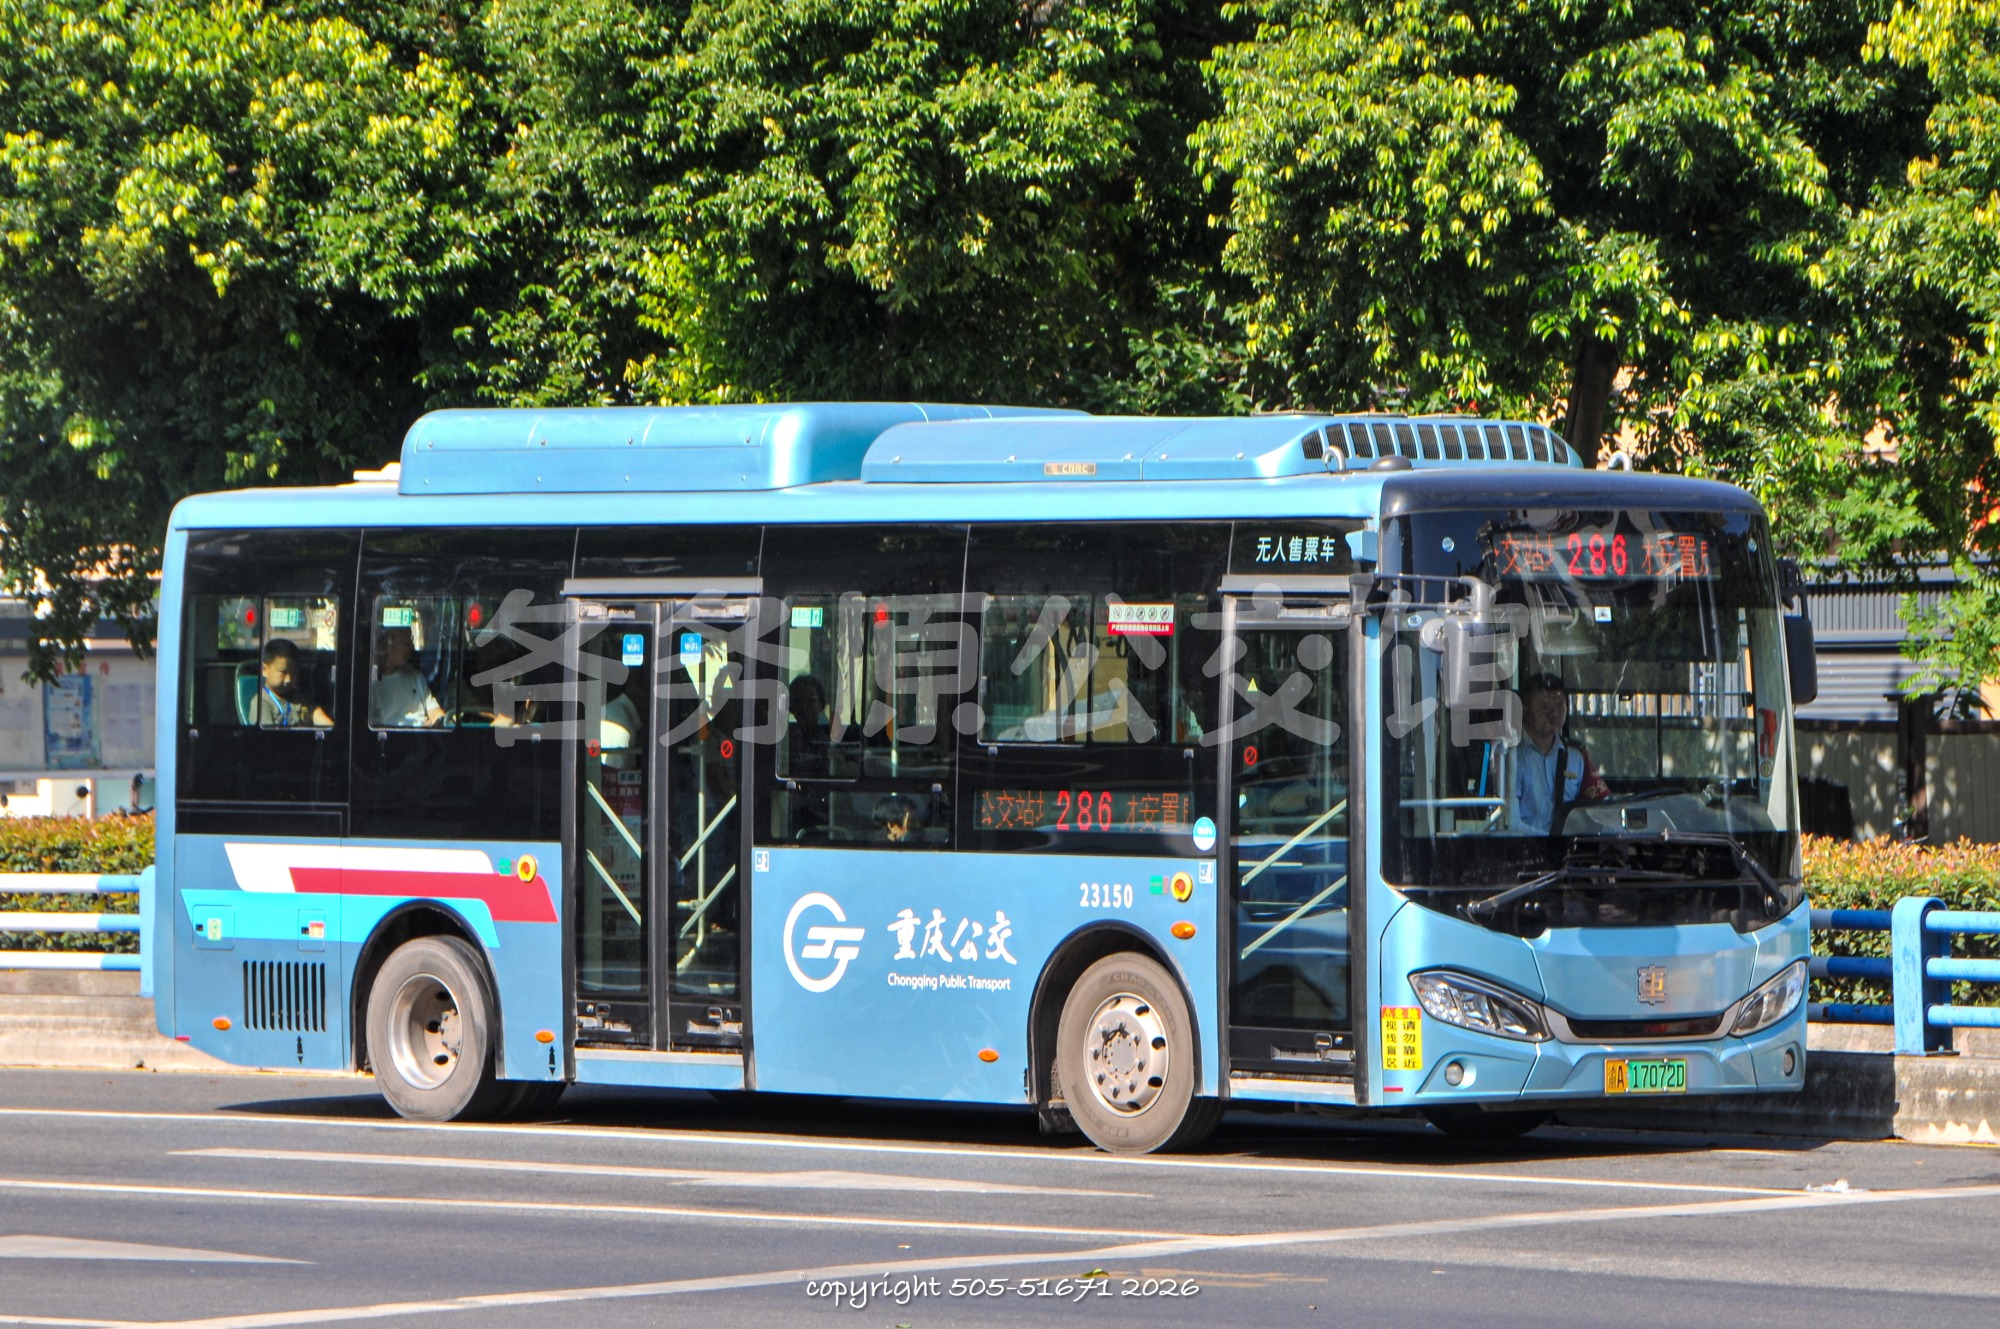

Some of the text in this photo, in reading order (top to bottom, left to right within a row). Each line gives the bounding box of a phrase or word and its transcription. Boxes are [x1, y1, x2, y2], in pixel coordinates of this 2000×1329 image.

[1255, 535, 1336, 563] 无人售票车
[1566, 533, 1628, 577] 286
[1056, 790, 1112, 832] 286
[1080, 882, 1134, 909] 23150
[886, 907, 1018, 966] 重庆公交
[887, 972, 1011, 992] Chongqing Public Transport
[1403, 1020, 1417, 1068] 请勿靠近
